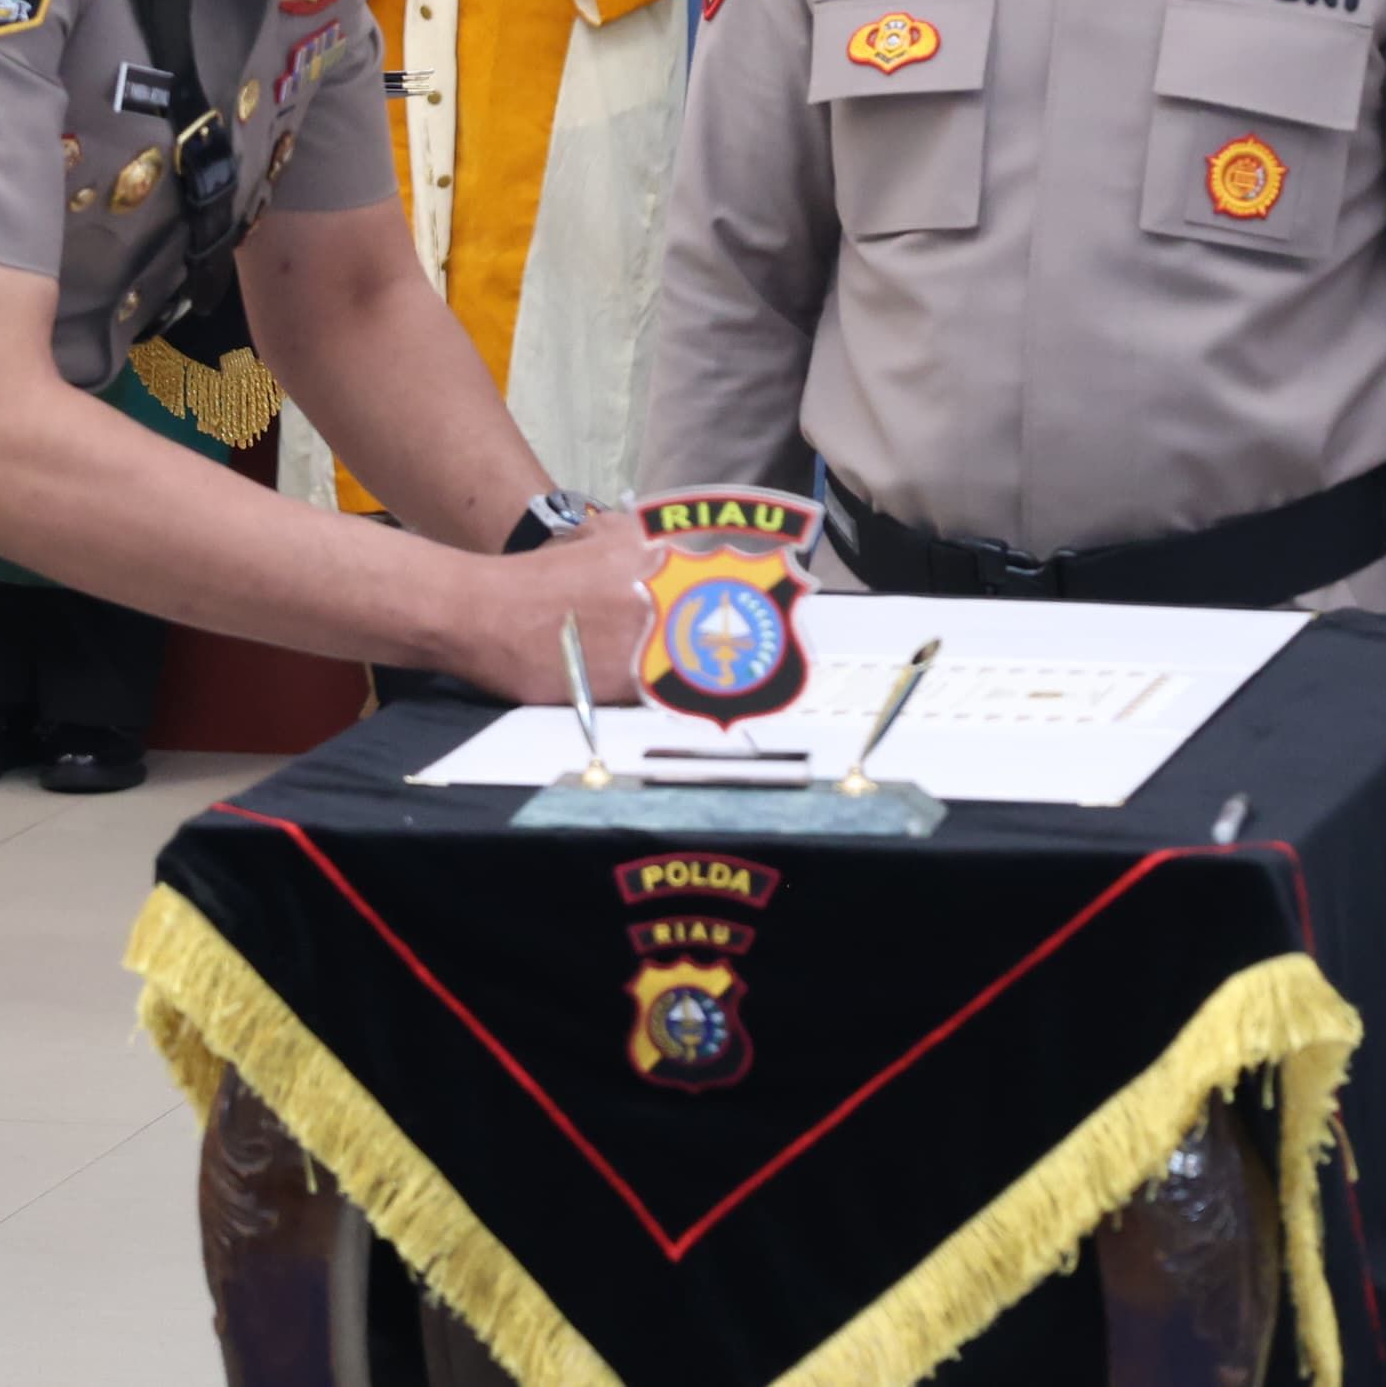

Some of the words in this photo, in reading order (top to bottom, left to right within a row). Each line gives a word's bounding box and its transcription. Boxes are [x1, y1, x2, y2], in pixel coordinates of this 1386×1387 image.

[660, 501, 785, 533] RIAU
[641, 860, 751, 898] POLDA
[653, 920, 731, 946] RIAU
